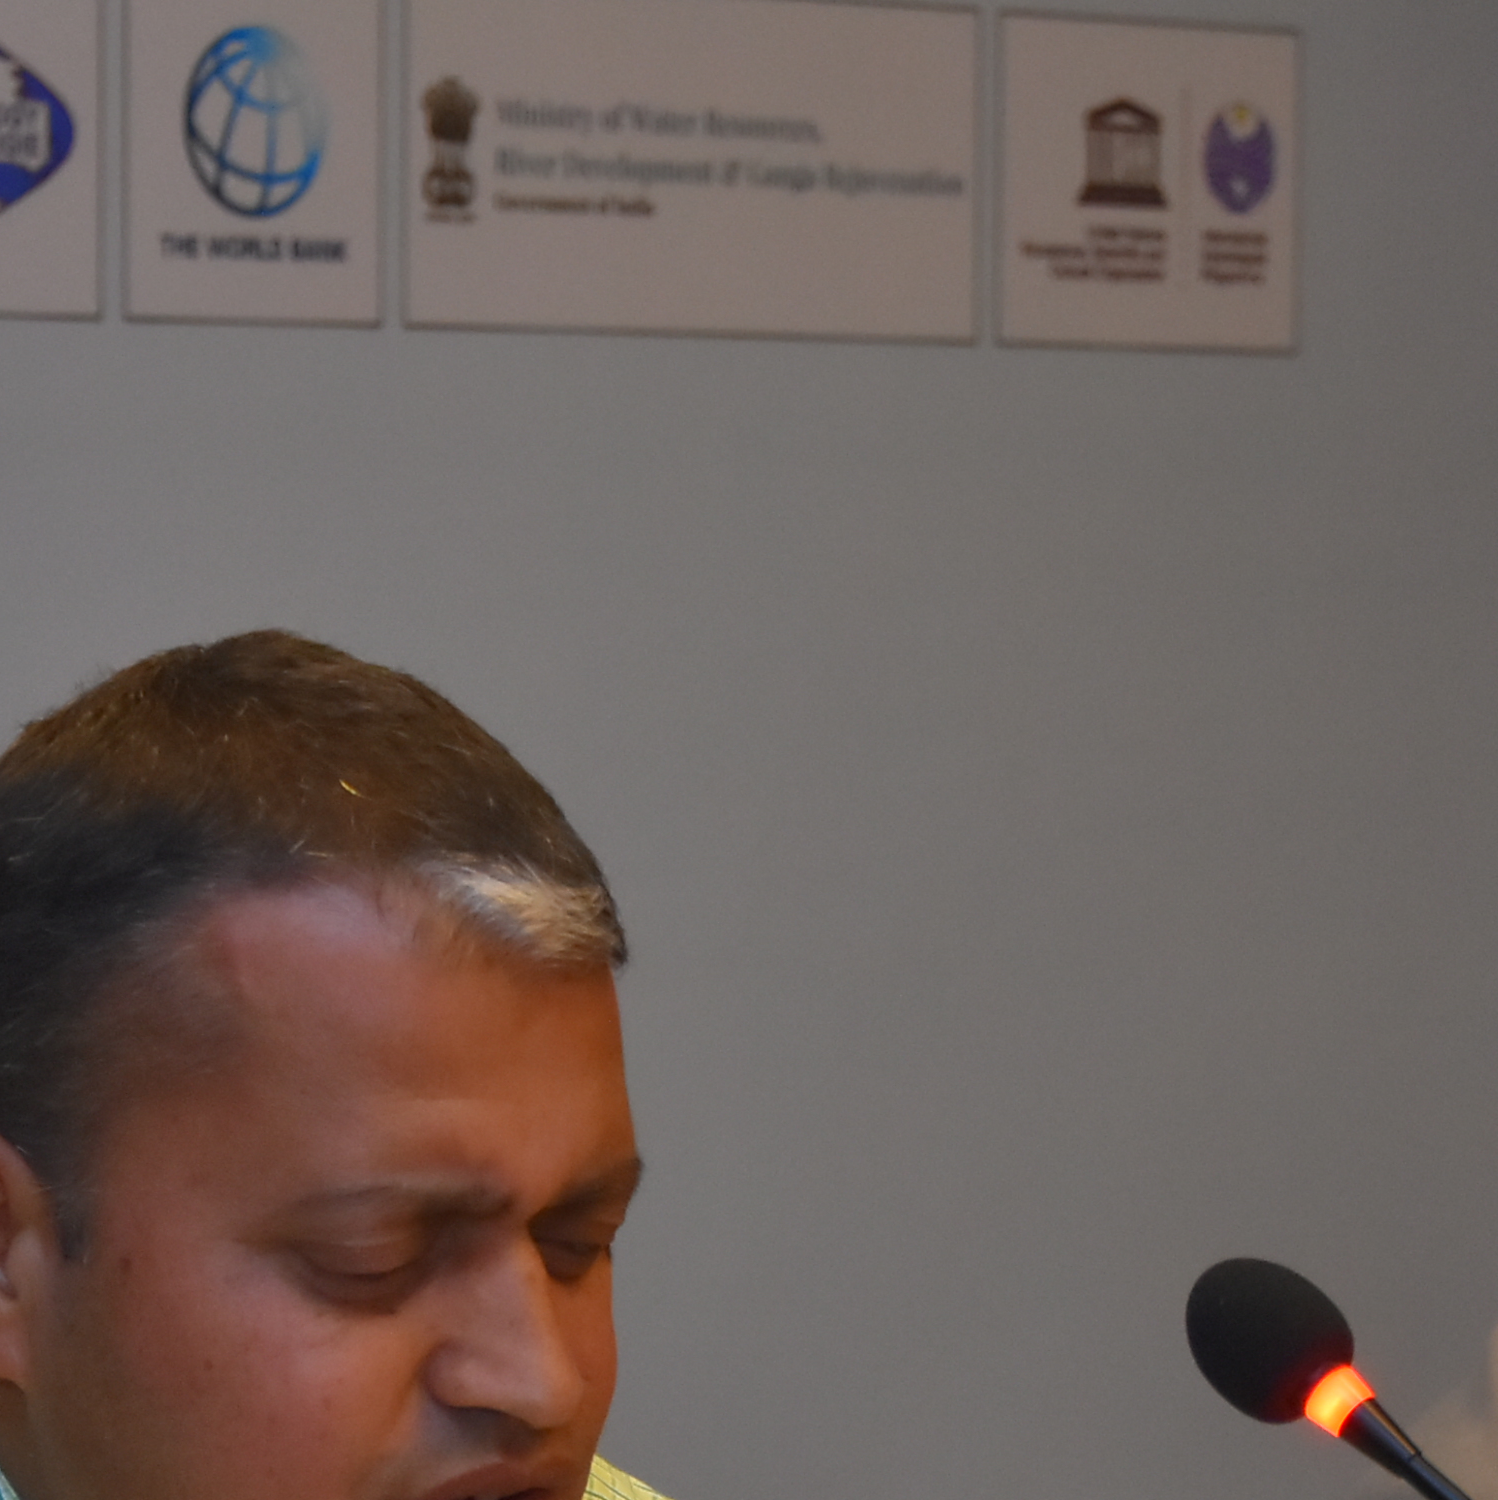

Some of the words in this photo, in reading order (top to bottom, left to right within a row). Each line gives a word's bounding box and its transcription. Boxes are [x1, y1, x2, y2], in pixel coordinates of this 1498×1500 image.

[160, 231, 198, 257] THE
[208, 236, 281, 261] WORLD
[291, 238, 346, 263] BANK
